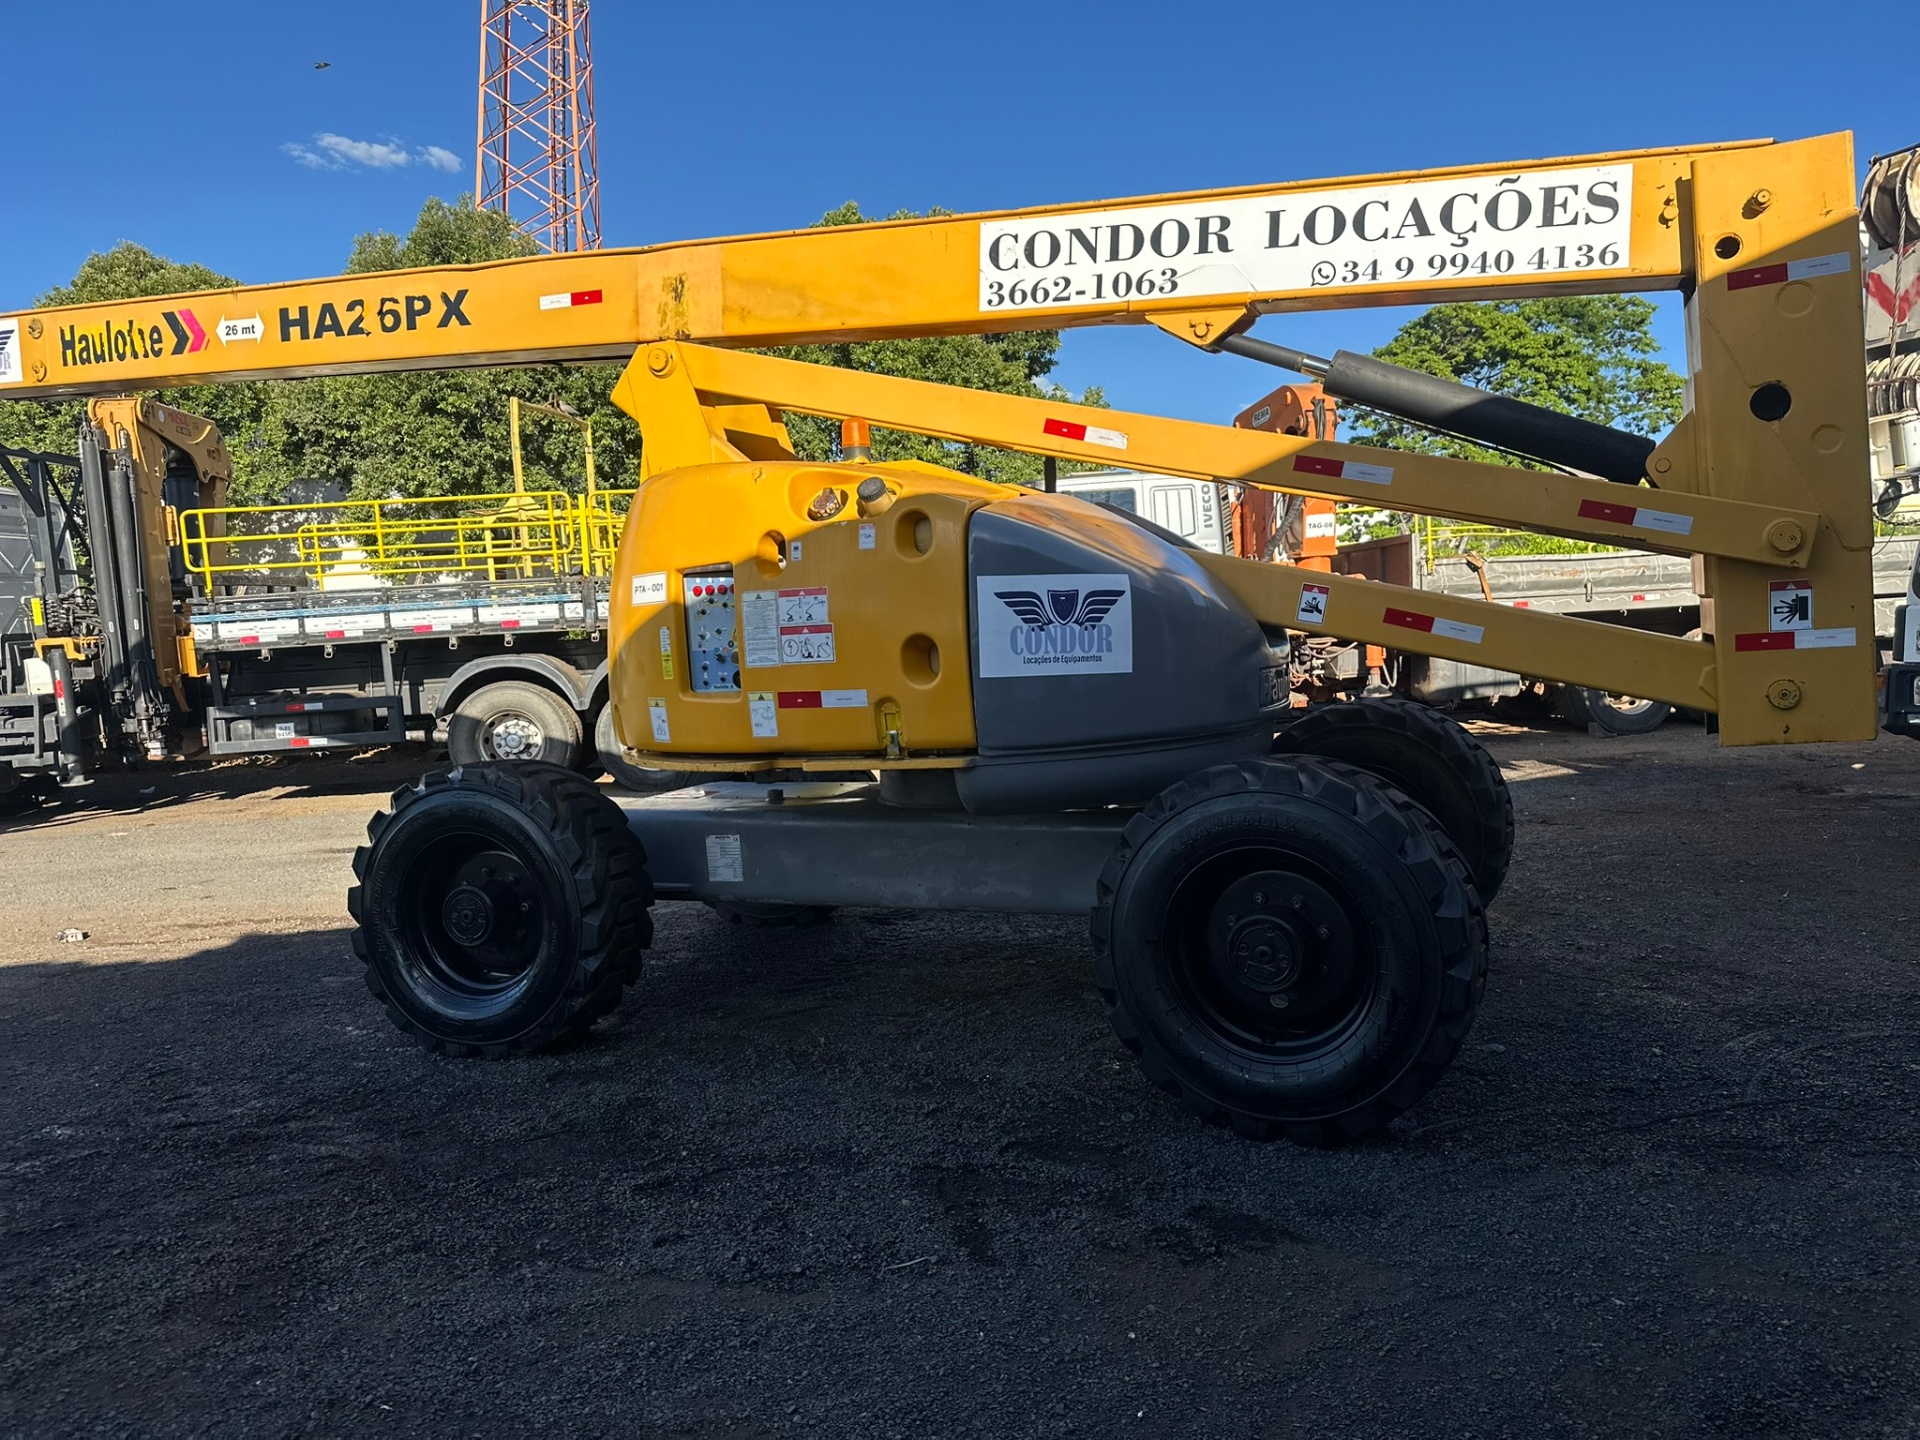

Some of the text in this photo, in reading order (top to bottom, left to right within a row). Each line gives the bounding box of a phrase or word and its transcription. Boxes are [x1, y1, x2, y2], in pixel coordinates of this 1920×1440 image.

[988, 175, 1620, 272] CONDOR LOCAÇÕES
[1342, 242, 1620, 284] 34 9 9940 4136
[987, 268, 1180, 308] 3662-1063
[225, 324, 256, 336] 26 mt
[1201, 484, 1213, 528] IVECO
[634, 585, 646, 594] PTA
[651, 582, 664, 593] 001
[1010, 623, 1113, 656] CONDOR
[1023, 655, 1103, 665] Locações de Equipamentos
